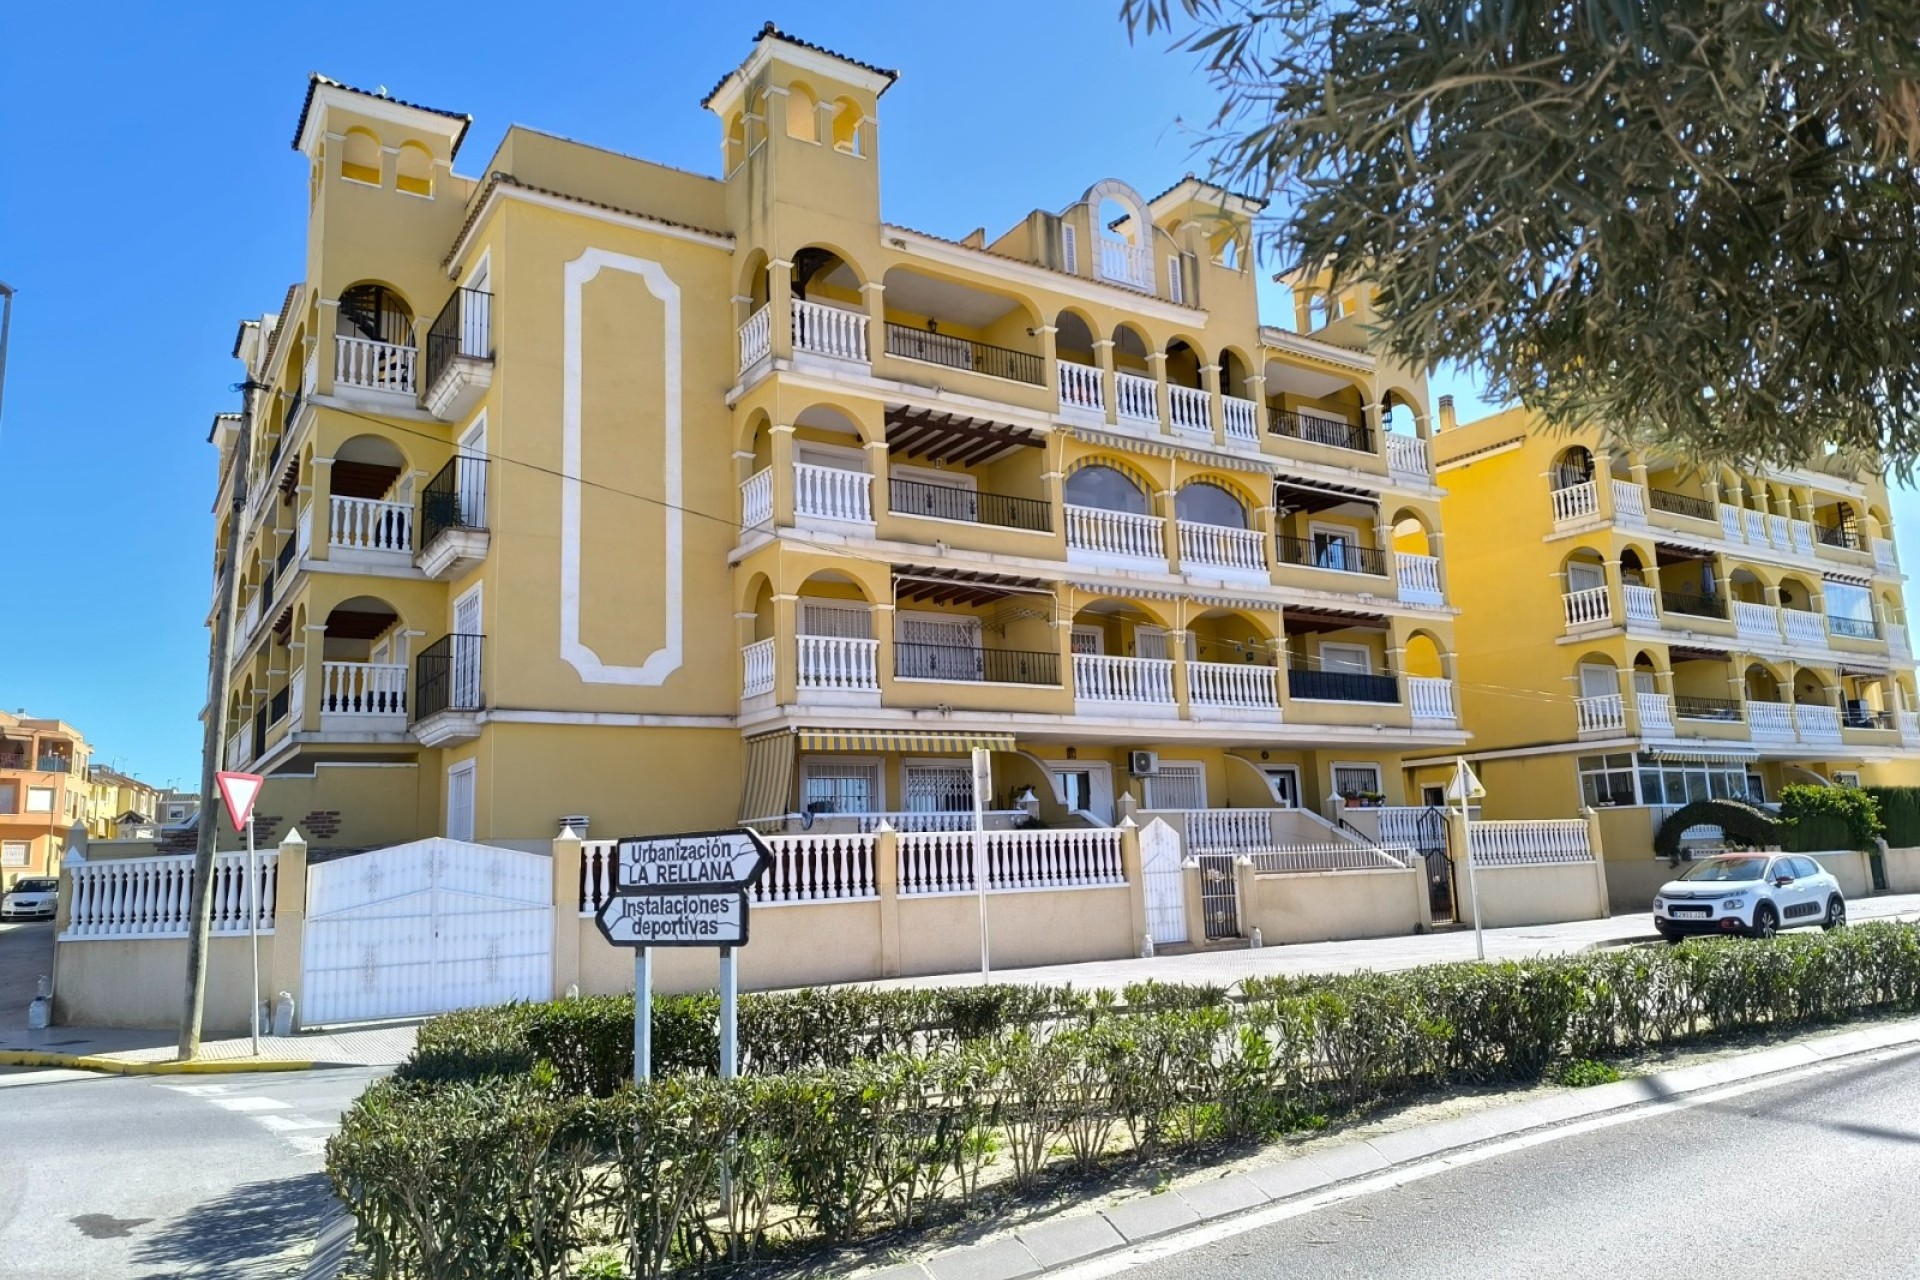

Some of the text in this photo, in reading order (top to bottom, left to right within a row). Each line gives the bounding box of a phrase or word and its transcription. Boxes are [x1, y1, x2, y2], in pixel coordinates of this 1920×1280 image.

[631, 840, 731, 863] Urbanización
[629, 861, 735, 884] LA RELLANA
[622, 896, 729, 917] Instalaciones
[632, 917, 718, 939] deportivas
